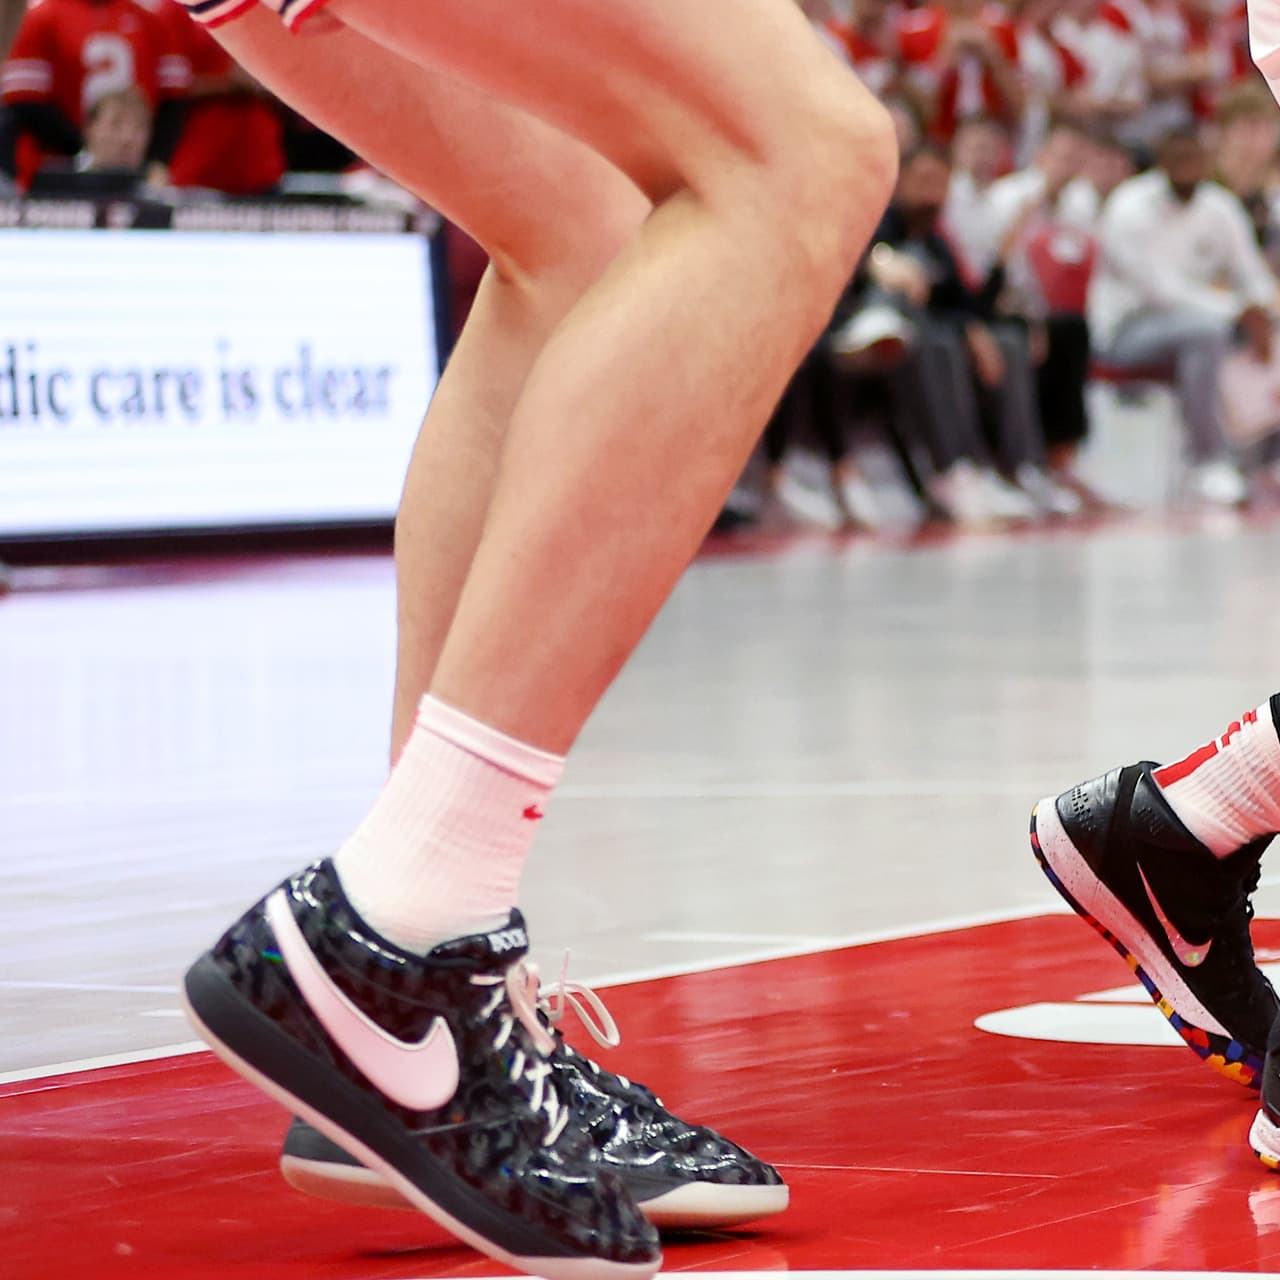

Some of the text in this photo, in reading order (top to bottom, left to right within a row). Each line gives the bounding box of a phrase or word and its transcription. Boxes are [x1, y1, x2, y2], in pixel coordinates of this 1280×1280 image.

[90, 366, 201, 418] care
[217, 337, 257, 415] is
[274, 342, 394, 414] clear
